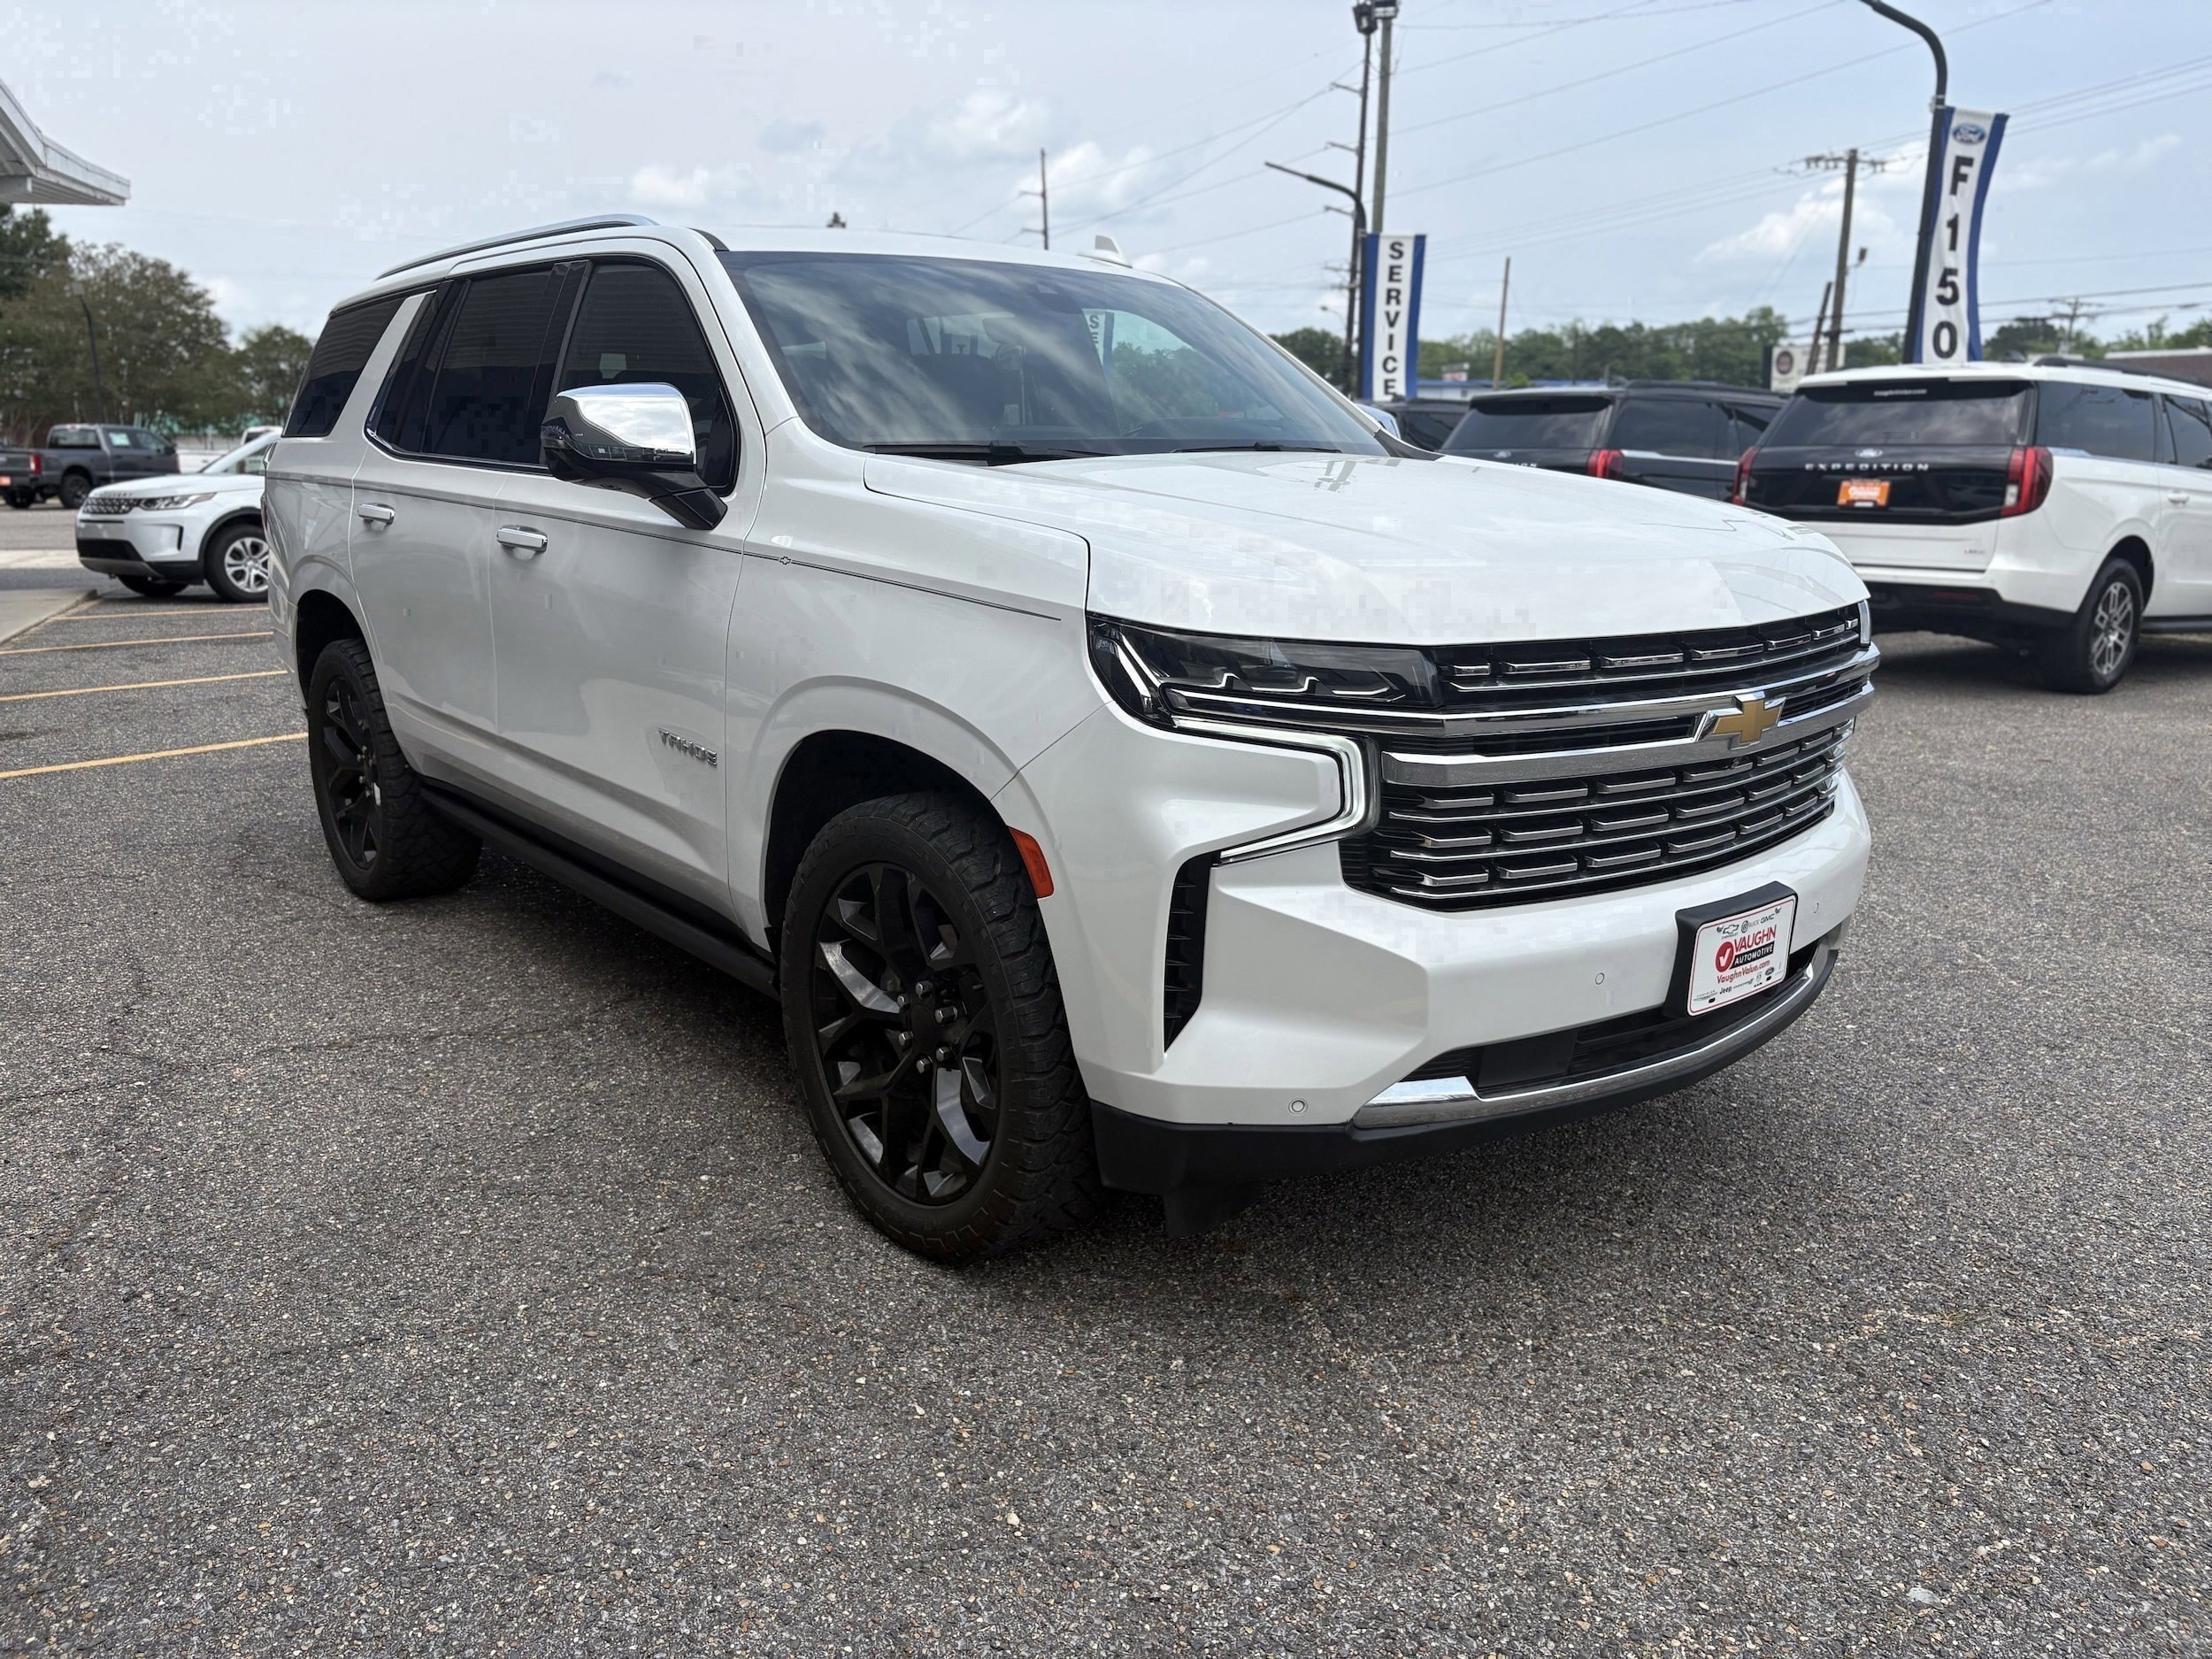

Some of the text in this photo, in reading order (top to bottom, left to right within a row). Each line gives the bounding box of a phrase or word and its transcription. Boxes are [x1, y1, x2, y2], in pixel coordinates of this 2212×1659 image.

[1932, 155, 1975, 360] F150
[1381, 241, 1404, 396] SERVICE
[1804, 463, 1930, 472] EXPEDITION
[657, 727, 718, 767] TAHOE
[1760, 913, 1775, 925] GMC
[1734, 924, 1777, 953] VAUGHN
[1734, 943, 1774, 966] AUTOMOTIVE
[1717, 960, 1770, 985] VaughnValue.com
[1719, 986, 1732, 995] Jeep
